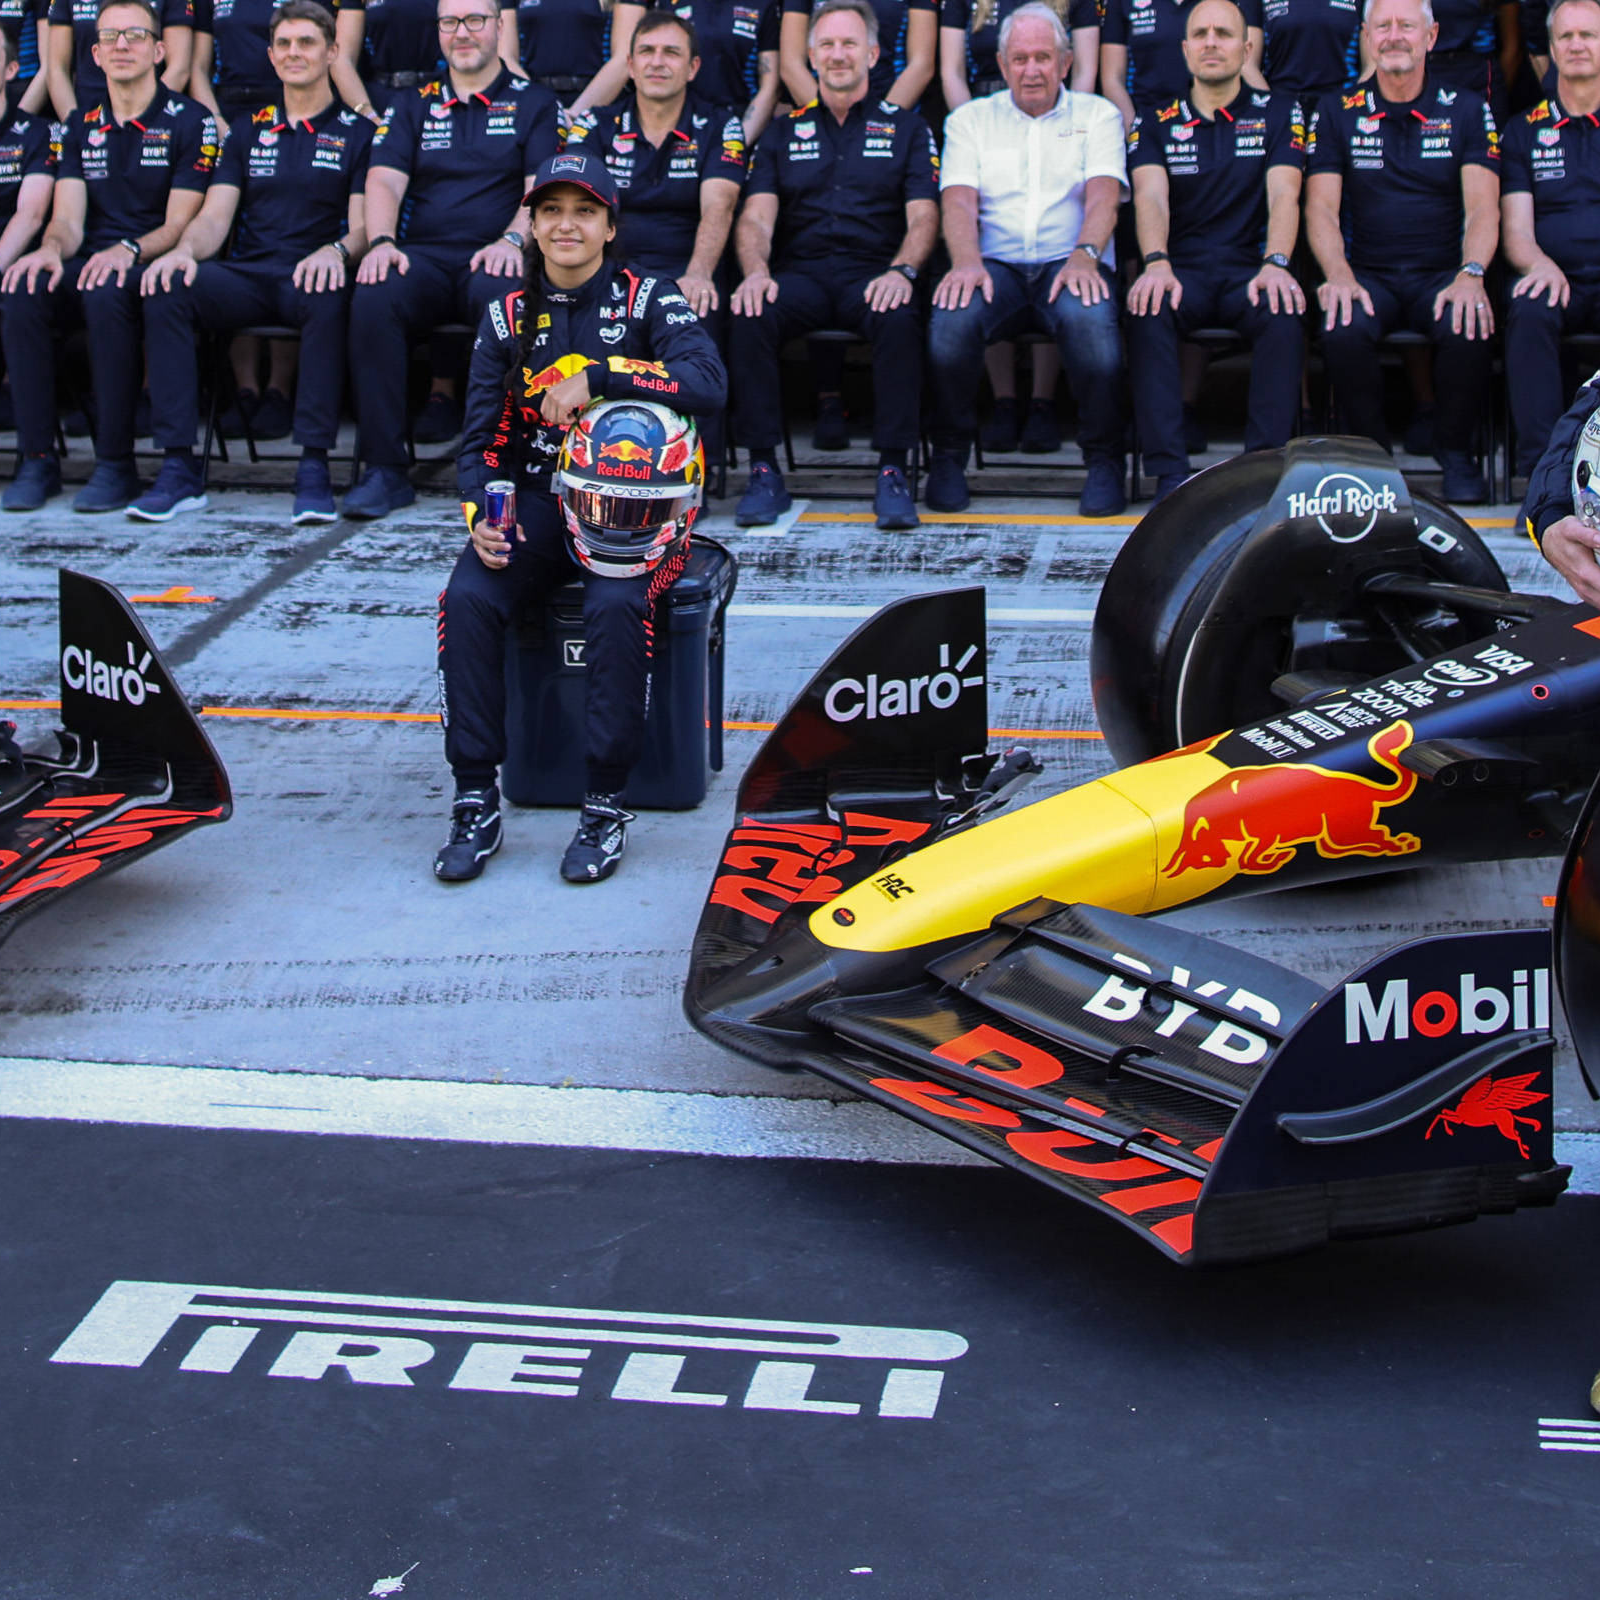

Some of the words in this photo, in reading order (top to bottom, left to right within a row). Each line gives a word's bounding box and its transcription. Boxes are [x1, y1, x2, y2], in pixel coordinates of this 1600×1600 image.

[632, 277, 657, 320] sparco
[488, 300, 510, 341] sparco
[633, 375, 654, 390] Red
[653, 377, 680, 394] Bull
[596, 462, 624, 477] Red
[624, 463, 652, 480] Bull
[605, 486, 666, 498] ACADEMY
[1287, 488, 1342, 519] Hard
[1345, 484, 1398, 518] Rock
[1432, 659, 1483, 682] CDW
[1473, 644, 1535, 676] VISA
[61, 644, 147, 708] Claro
[1403, 679, 1439, 697] AVA
[824, 671, 964, 723] Claro
[1380, 679, 1435, 708] TRADE
[1287, 710, 1346, 741] PIRELLI
[1333, 711, 1366, 730] WOLF
[1343, 705, 1382, 726] ARCTIC
[1239, 727, 1281, 755] Mobil
[1265, 719, 1317, 750] infinitum
[875, 873, 916, 900] HRC
[1082, 953, 1283, 1067] BYB
[1342, 967, 1552, 1045] Mobil
[49, 1280, 969, 1419] PIRELLI
